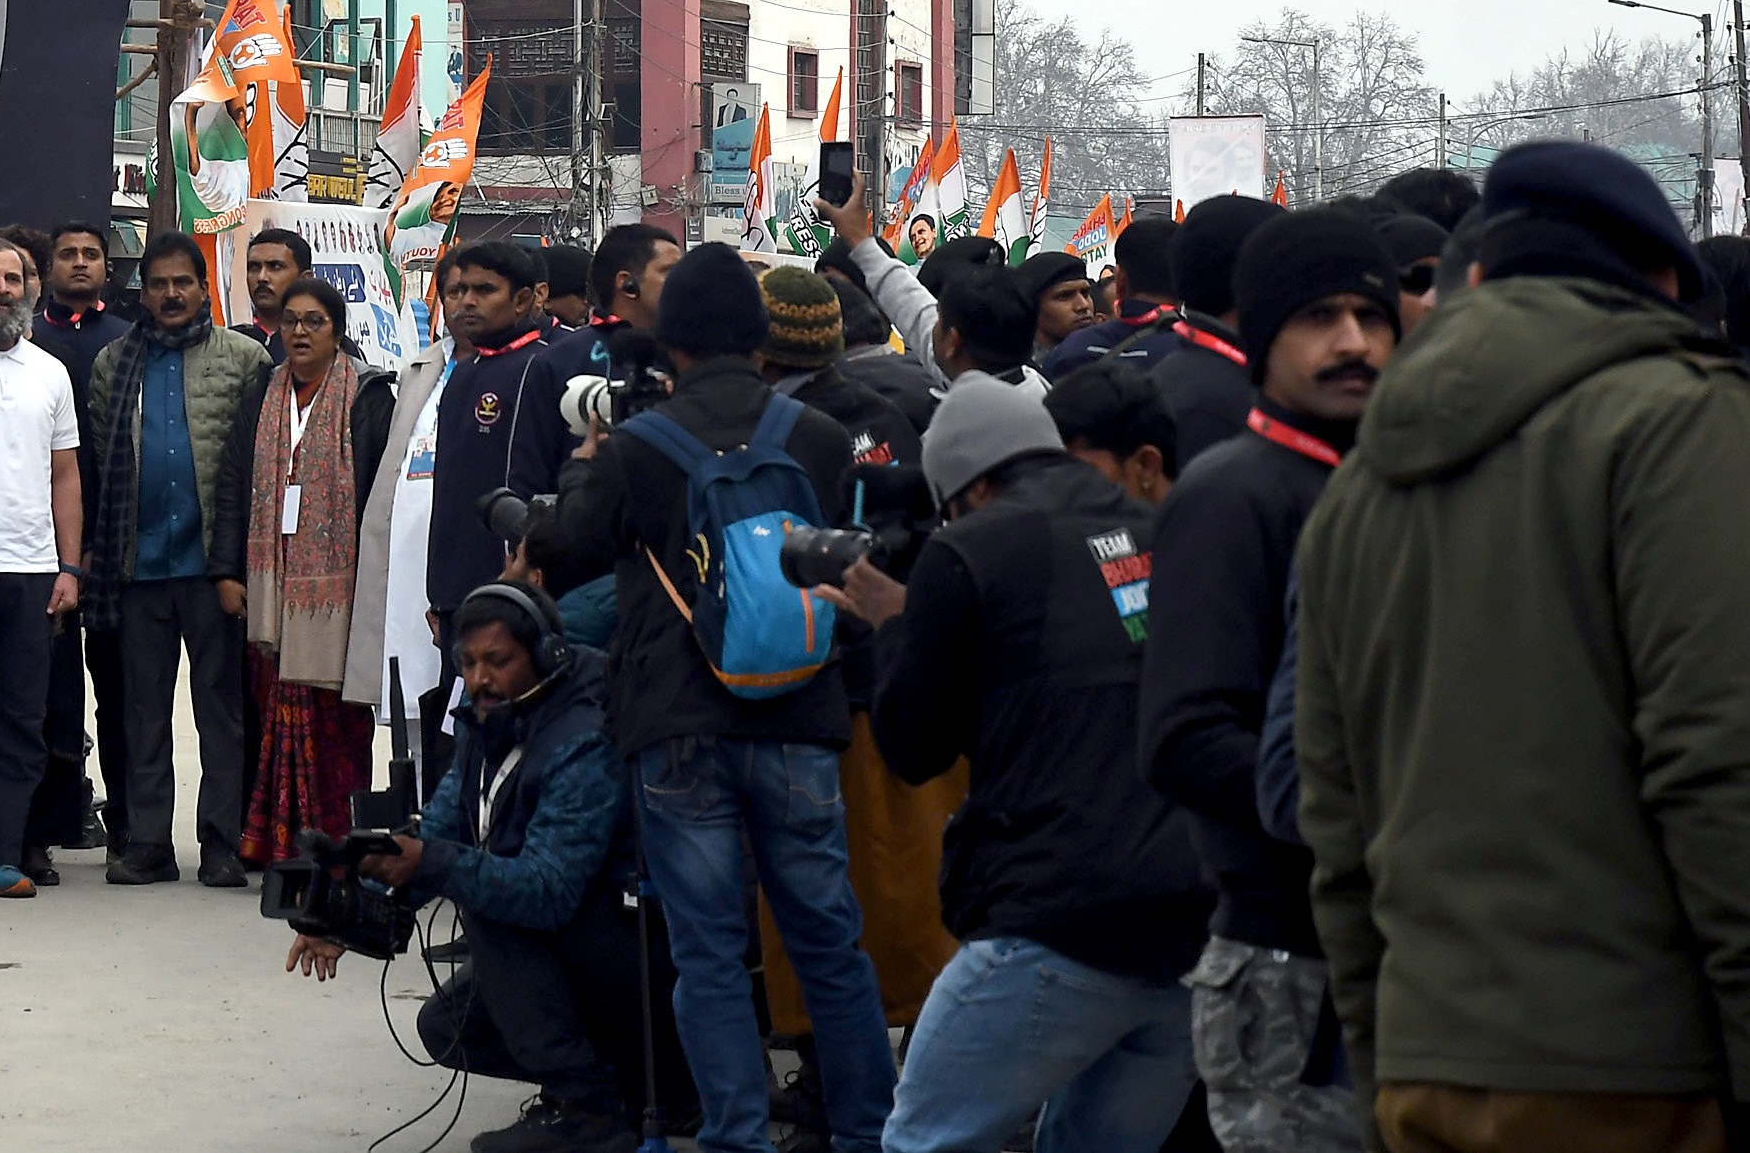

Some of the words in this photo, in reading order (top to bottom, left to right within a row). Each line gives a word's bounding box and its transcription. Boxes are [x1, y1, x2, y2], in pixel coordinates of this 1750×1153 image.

[443, 98, 465, 133] RAT
[715, 185, 740, 195] Bless
[790, 205, 823, 261] GRESS
